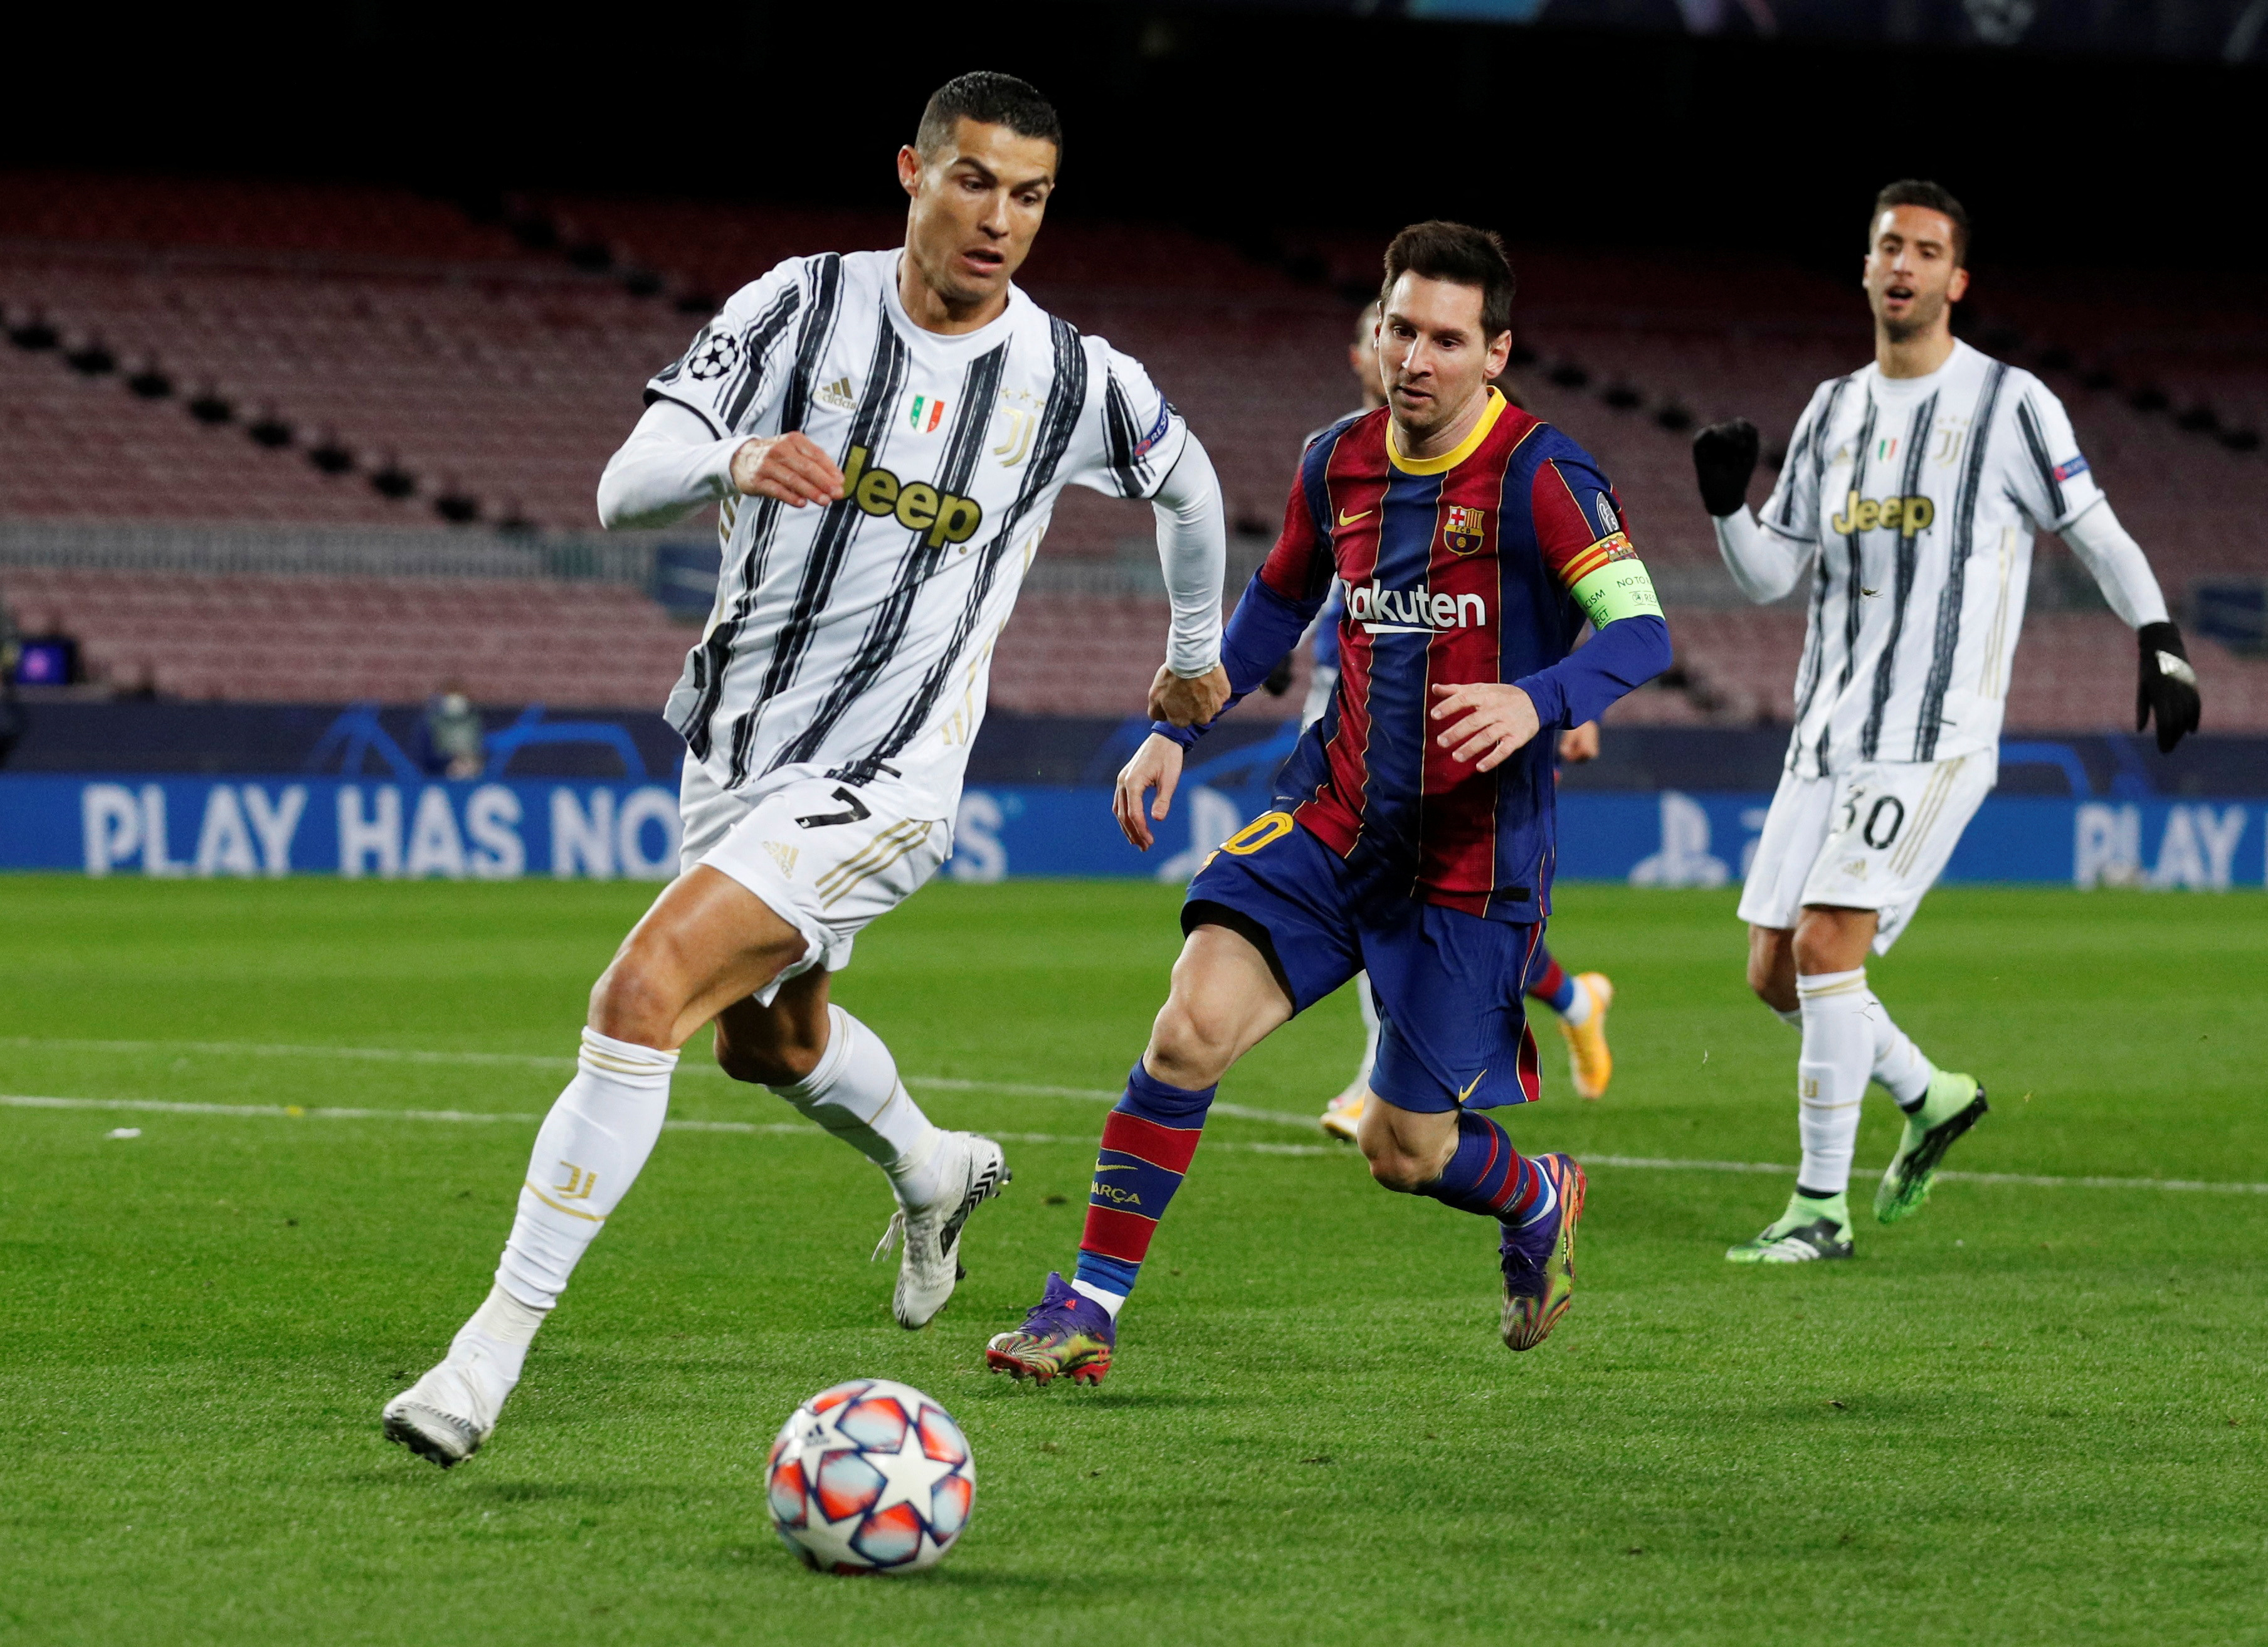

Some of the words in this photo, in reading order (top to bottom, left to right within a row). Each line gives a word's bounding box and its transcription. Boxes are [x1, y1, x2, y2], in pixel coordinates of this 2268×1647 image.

[840, 445, 982, 548] Jeep
[1832, 489, 1935, 538] Jeep
[1617, 577, 1633, 588] NO
[1644, 593, 1657, 603] RES
[794, 786, 872, 829] 7
[82, 783, 309, 878] PLAY
[336, 783, 527, 879] HAS
[549, 785, 683, 879] NO
[1220, 812, 1294, 855] 0
[2073, 802, 2249, 890] PLAY
[1090, 1180, 1141, 1205] ARÇA
